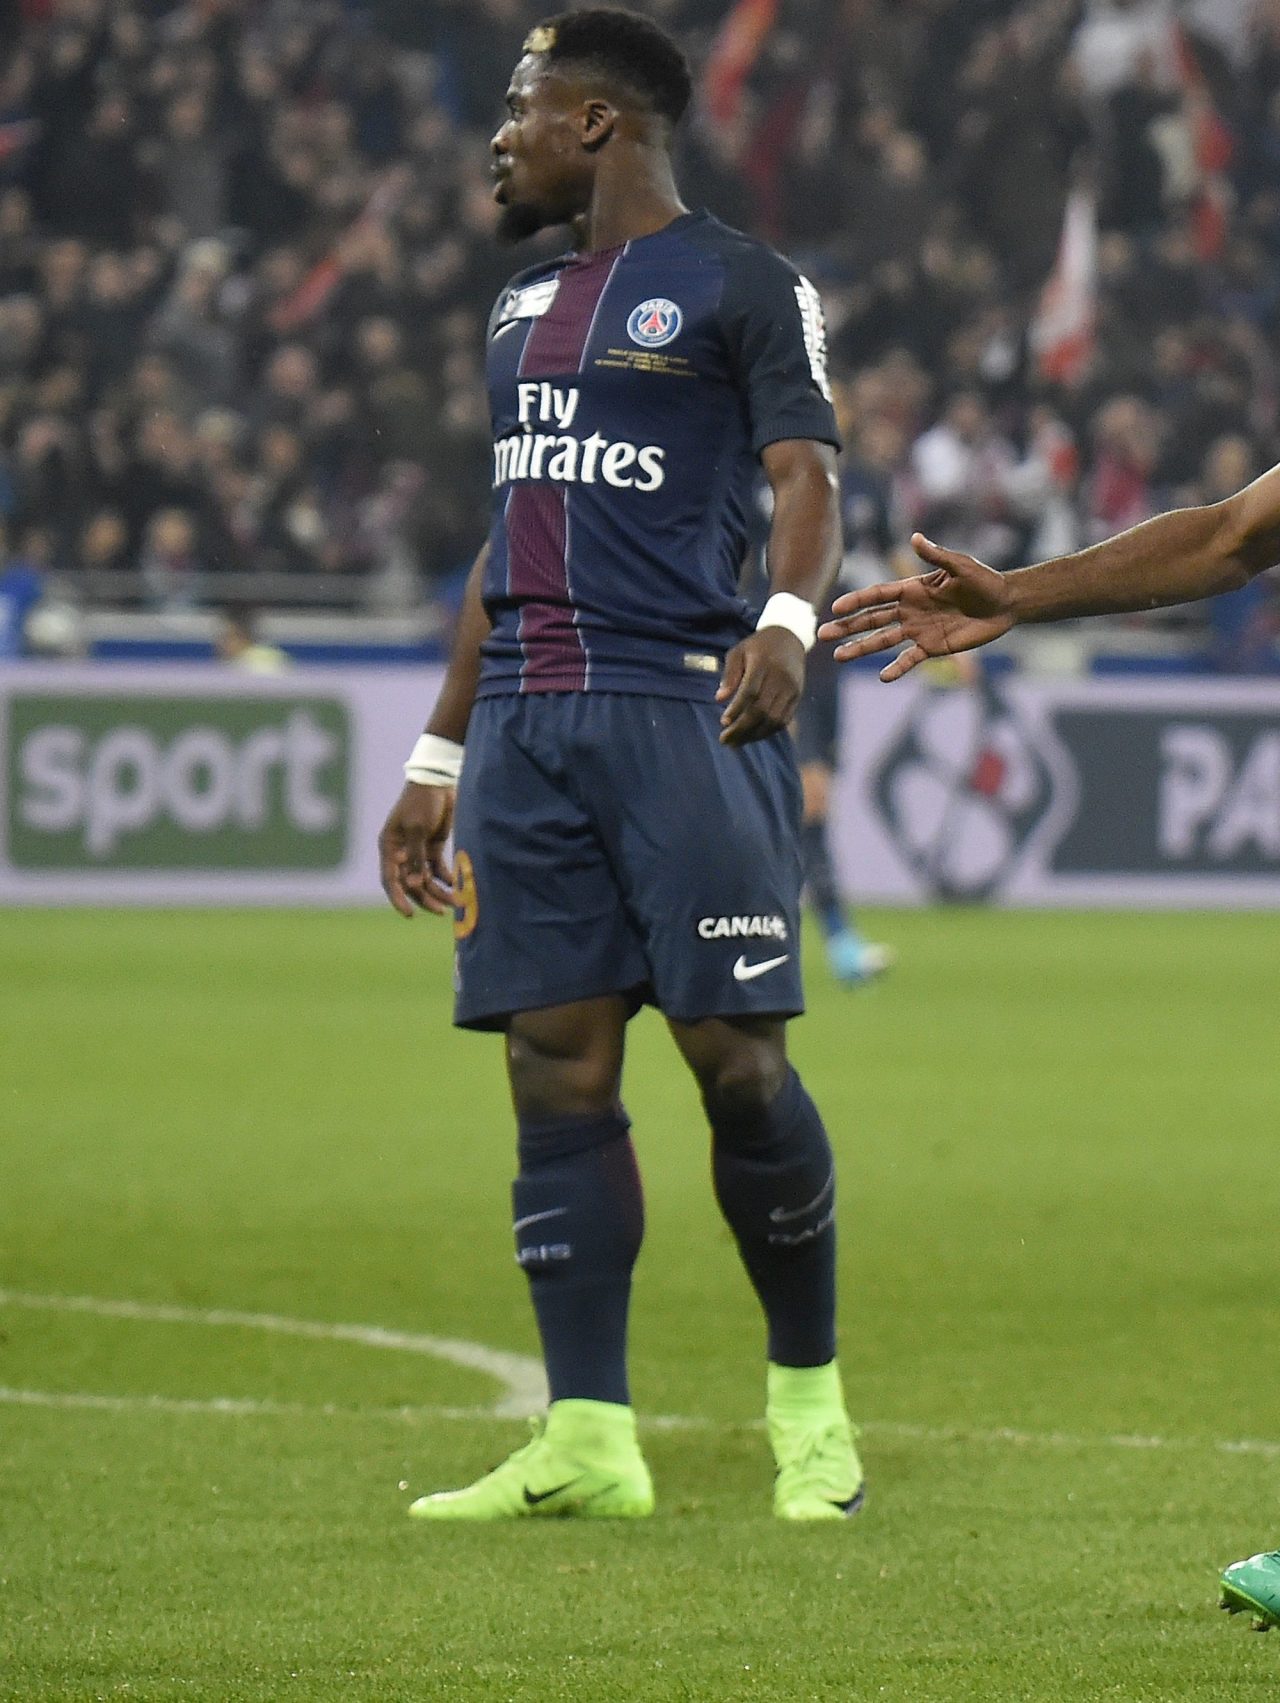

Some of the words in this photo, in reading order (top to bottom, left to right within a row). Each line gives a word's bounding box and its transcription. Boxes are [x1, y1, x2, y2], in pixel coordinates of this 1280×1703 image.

[518, 382, 579, 429] Fly
[492, 430, 666, 492] mirates
[20, 707, 336, 859] sport
